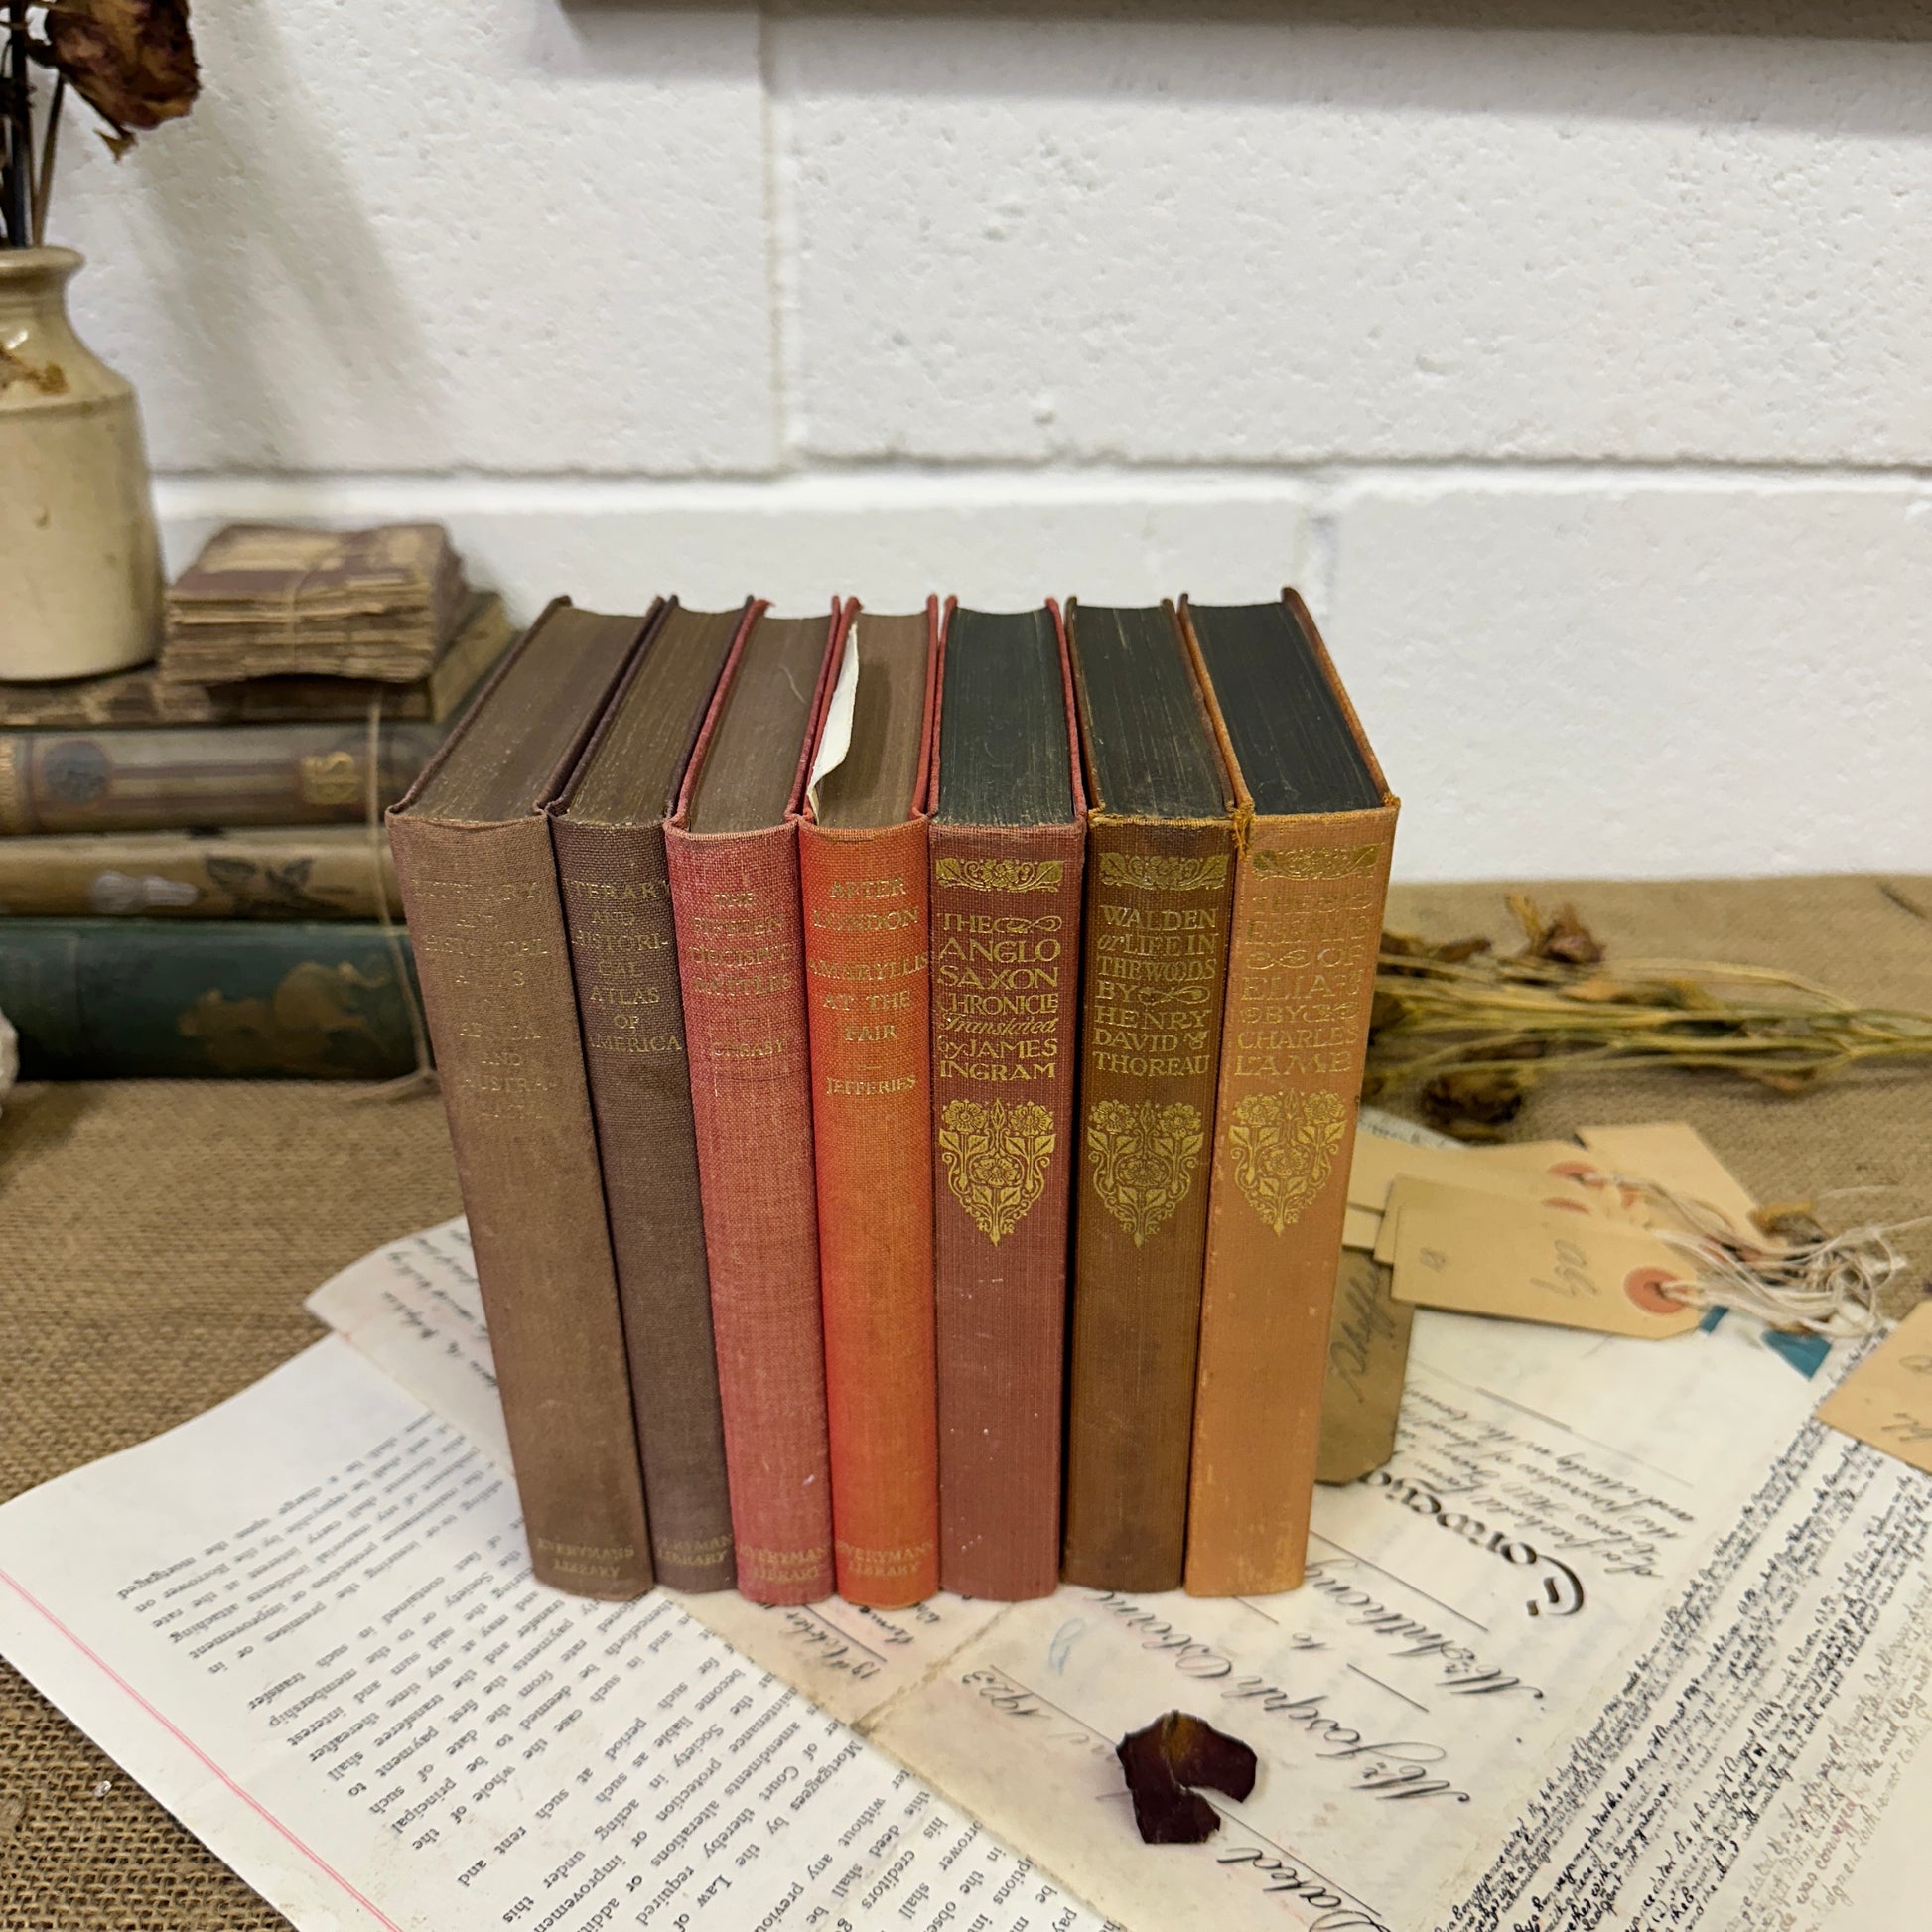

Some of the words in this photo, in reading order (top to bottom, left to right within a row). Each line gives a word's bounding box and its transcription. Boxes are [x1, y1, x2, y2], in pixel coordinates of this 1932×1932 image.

[828, 877, 907, 898] AFTER
[812, 905, 919, 932] LONDON
[936, 912, 993, 934] THE
[1099, 904, 1220, 931] WALDEN
[938, 937, 1062, 963] ANGLO
[1123, 933, 1181, 957] LIFE
[1184, 933, 1221, 956] IN
[1317, 944, 1365, 969] OF
[807, 952, 929, 981] AMARYLLIS
[936, 964, 1060, 991] SAXON
[1096, 955, 1143, 981] THE
[1140, 958, 1217, 982] WOODS
[590, 985, 661, 1005] ATLAS
[1094, 979, 1140, 1004] BY
[1240, 973, 1336, 1001] ELIA
[822, 993, 857, 1012] AT
[865, 991, 912, 1012] THE
[1261, 1003, 1308, 1025] BY
[613, 1013, 640, 1031] OF
[938, 1012, 1060, 1035] Translated
[1094, 1004, 1213, 1031] HENRY
[844, 1023, 898, 1042] FAIR
[1093, 1028, 1179, 1053] DAVID
[1236, 1025, 1359, 1050] CHARLES
[963, 1038, 1059, 1059] JAMES
[938, 1060, 1057, 1082] INGRAM
[1092, 1050, 1212, 1077] THOREAU
[1233, 1050, 1353, 1077] LAMB
[116, 1556, 196, 1600] mortgaged
[134, 1598, 156, 1613] on
[151, 1607, 184, 1628] rate
[168, 1602, 238, 1644] attaching
[188, 1602, 286, 1659] improvement
[263, 1600, 327, 1642] premises
[236, 1645, 254, 1659] or
[315, 1643, 348, 1667] such
[511, 1617, 574, 1671] payments
[207, 1660, 225, 1674] in
[389, 1651, 421, 1676] sum
[697, 1656, 720, 1675] for
[247, 1671, 306, 1710] transfer
[268, 1667, 357, 1727] membership
[352, 1679, 381, 1704] and
[385, 1682, 421, 1708] time
[482, 1674, 508, 1695] the
[517, 1669, 554, 1698] from
[589, 1674, 621, 1702] such
[656, 1681, 688, 1709] such
[693, 1667, 746, 1712] become
[447, 1698, 479, 1723] first
[485, 1703, 511, 1724] the
[518, 1684, 571, 1730] deemed
[729, 1694, 754, 1716] the
[285, 1705, 345, 1746] interest
[372, 1693, 444, 1747] transferee
[553, 1708, 583, 1733] case
[652, 1715, 694, 1748] liable
[308, 1712, 380, 1762] thereafter
[445, 1728, 478, 1756] date
[494, 1732, 514, 1748] to
[521, 1737, 548, 1760] the
[604, 1716, 647, 1761] period
[672, 1723, 724, 1768] Society
[374, 1725, 439, 1777] payment
[465, 1754, 489, 1773] be
[631, 1750, 649, 1768] as
[723, 1721, 800, 1796] amendments
[801, 1742, 818, 1762] of
[326, 1750, 363, 1781] shall
[416, 1763, 434, 1783] of
[575, 1766, 593, 1783] at
[789, 1739, 863, 1811] Mortgagees
[346, 1781, 367, 1796] to
[471, 1765, 516, 1802] whole
[594, 1771, 628, 1803] such
[648, 1772, 666, 1789] in
[654, 1756, 722, 1822] protection
[758, 1765, 799, 1801] Court
[367, 1785, 405, 1814] such
[389, 1776, 457, 1834] principal
[534, 1788, 569, 1819] such
[903, 1790, 930, 1816] this
[449, 1804, 467, 1825] of
[593, 1798, 639, 1842] acting
[765, 1815, 790, 1835] by
[837, 1797, 886, 1847] without
[922, 1815, 949, 1839] his
[411, 1827, 440, 1850] the
[492, 1825, 527, 1855] rent
[630, 1830, 647, 1848] or
[649, 1799, 720, 1867] alterations
[702, 1807, 755, 1859] thereby
[868, 1824, 900, 1858] deed
[734, 1843, 760, 1867] the
[806, 1853, 833, 1881] any
[985, 1846, 1003, 1862] in
[456, 1859, 487, 1887] and
[542, 1850, 586, 1889] under
[830, 1863, 863, 1898] shall
[860, 1849, 915, 1910] creditors
[958, 1869, 984, 1895] the
[625, 1874, 642, 1893] or
[634, 1864, 695, 1926] required
[696, 1873, 733, 1908] Law
[1035, 1884, 1058, 1904] be
[501, 1895, 534, 1923] this
[897, 1881, 929, 1920] shall
[672, 1912, 690, 1931] of
[805, 1905, 829, 1924] be
